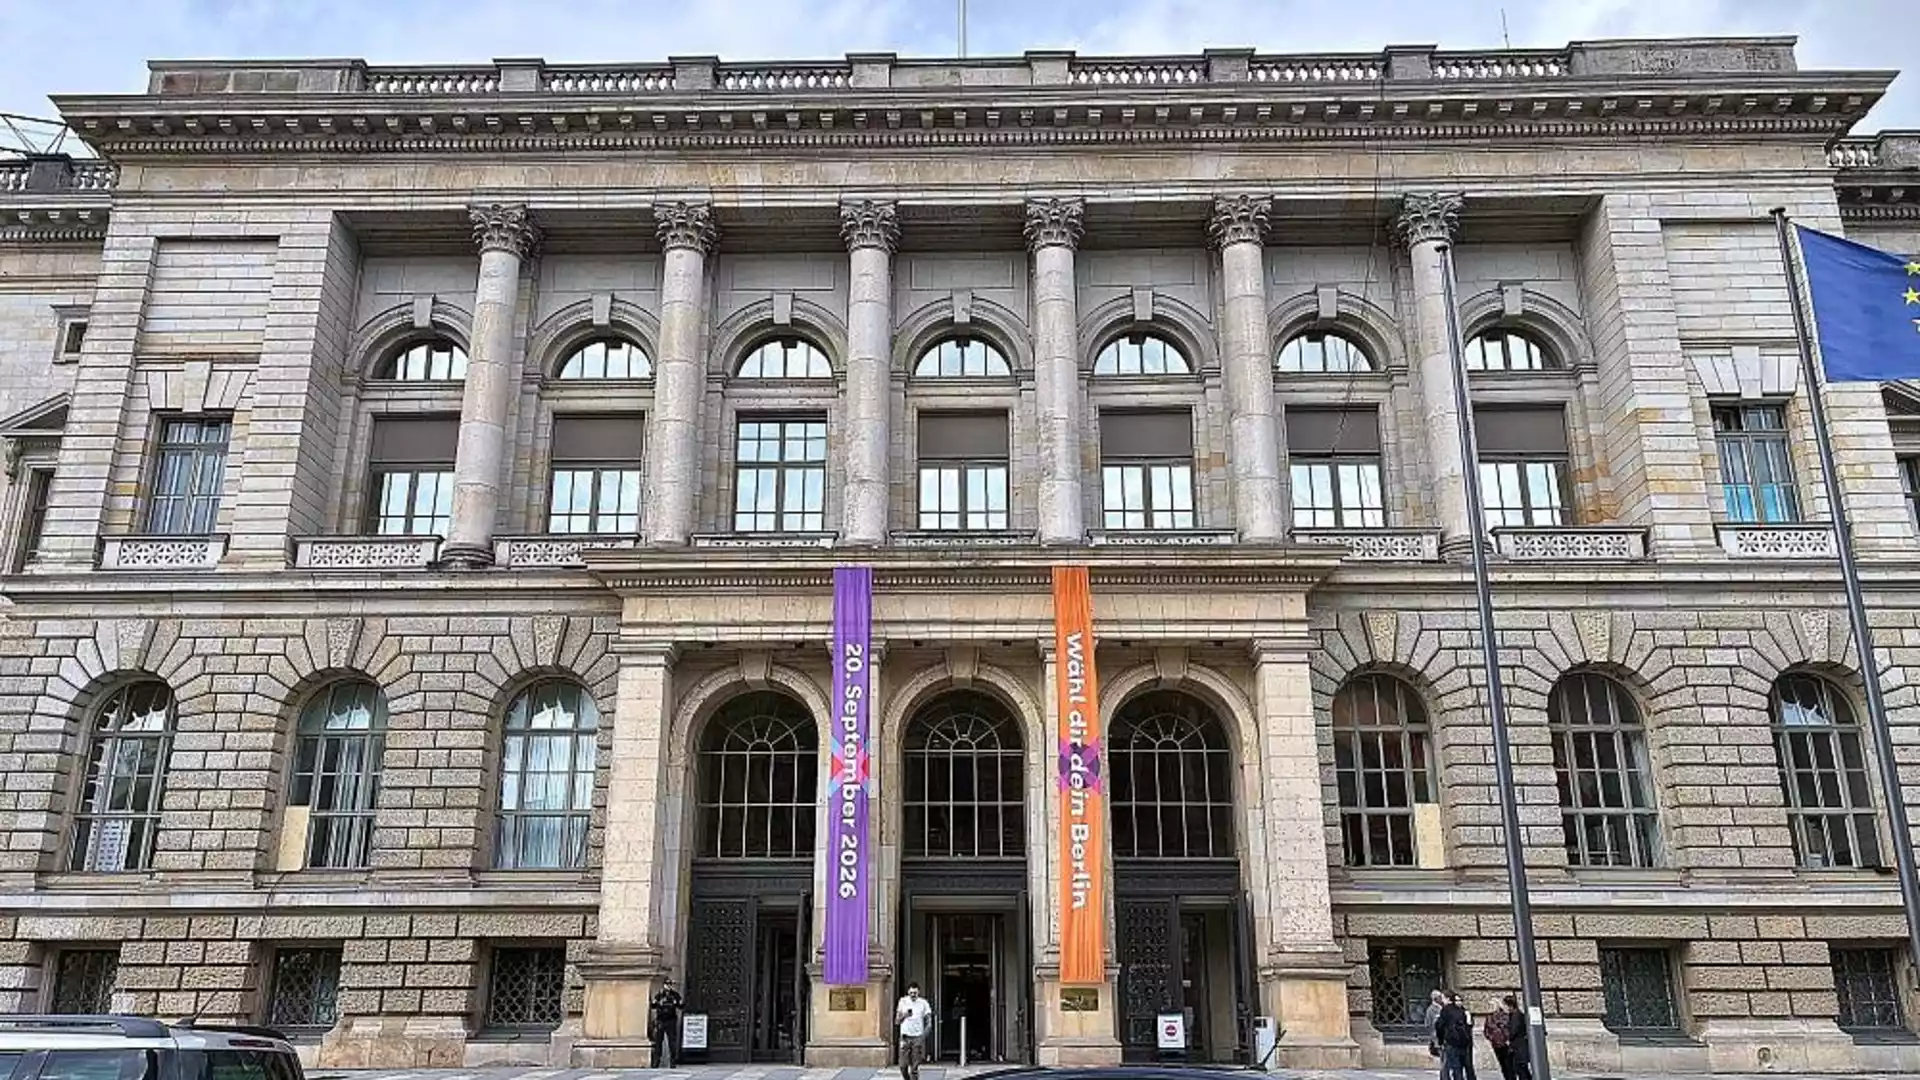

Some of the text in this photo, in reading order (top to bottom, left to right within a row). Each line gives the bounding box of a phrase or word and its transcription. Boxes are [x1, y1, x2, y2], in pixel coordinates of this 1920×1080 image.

[1069, 710, 1087, 747] dir
[839, 644, 862, 898] 20. September 2026
[1070, 753, 1090, 816] dein
[1071, 823, 1091, 908] Berlin
